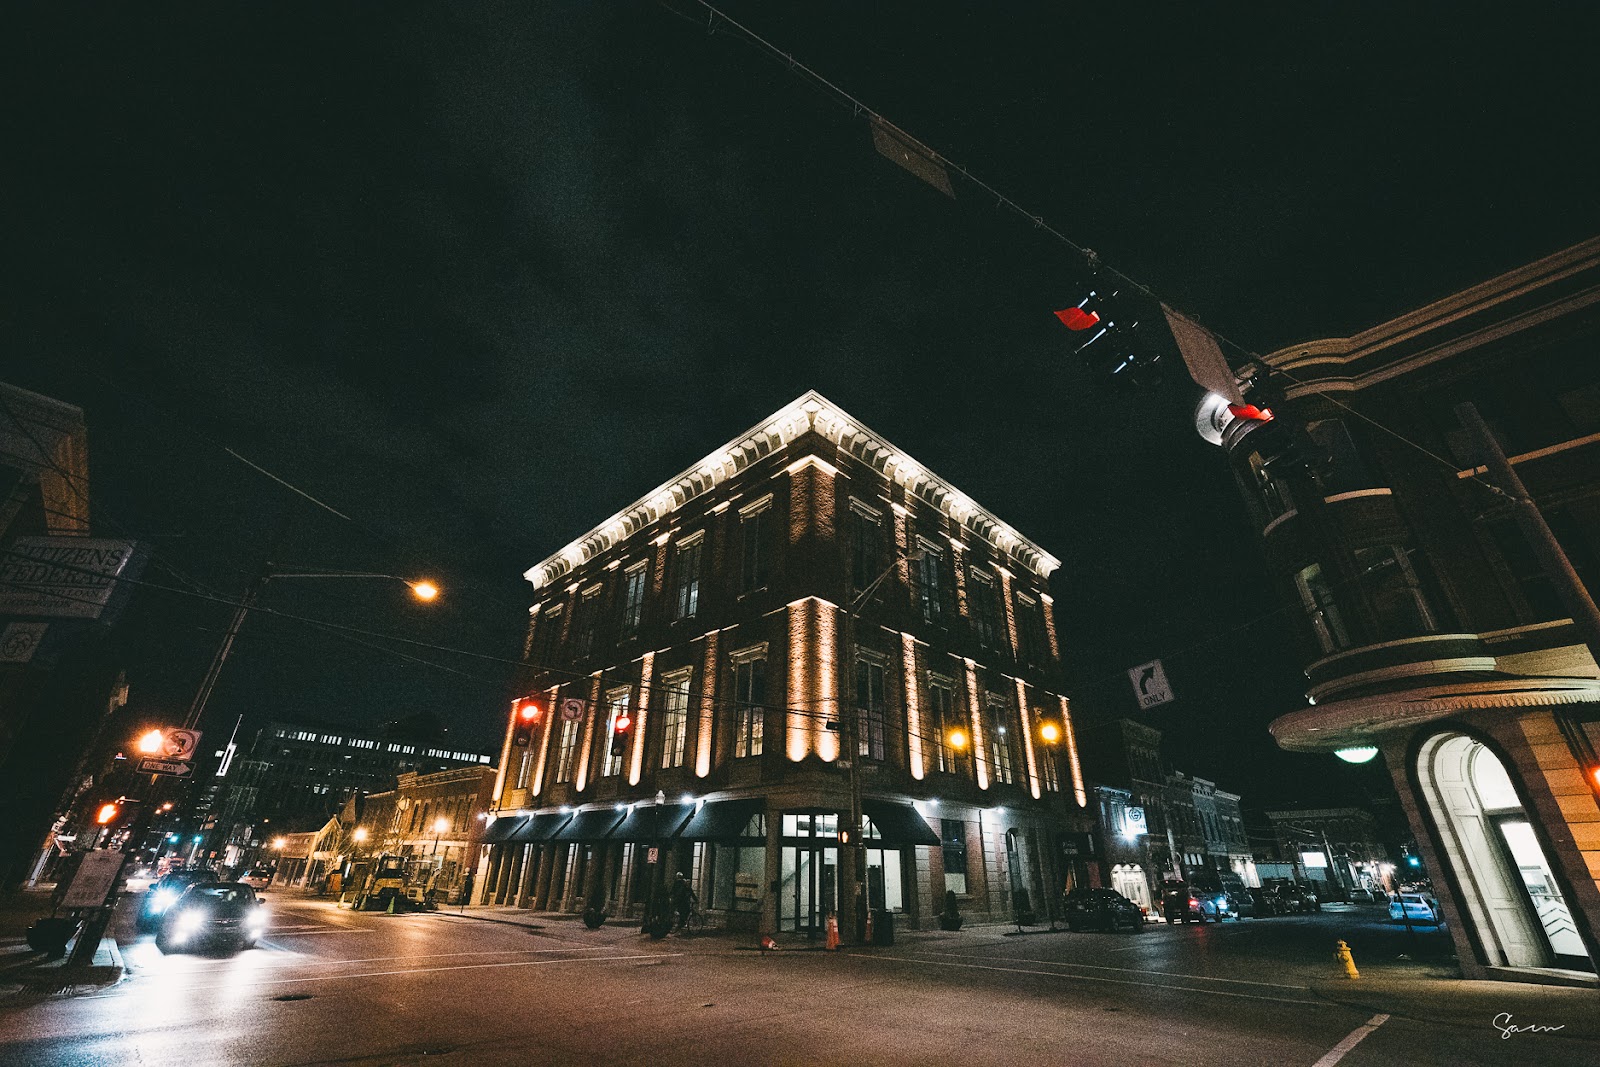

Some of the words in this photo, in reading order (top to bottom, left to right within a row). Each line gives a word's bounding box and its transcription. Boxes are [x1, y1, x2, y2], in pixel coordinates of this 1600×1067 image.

[8, 544, 124, 566] CITIZENS
[1, 563, 110, 585] FEDERAL
[1143, 692, 1165, 705] ONLY
